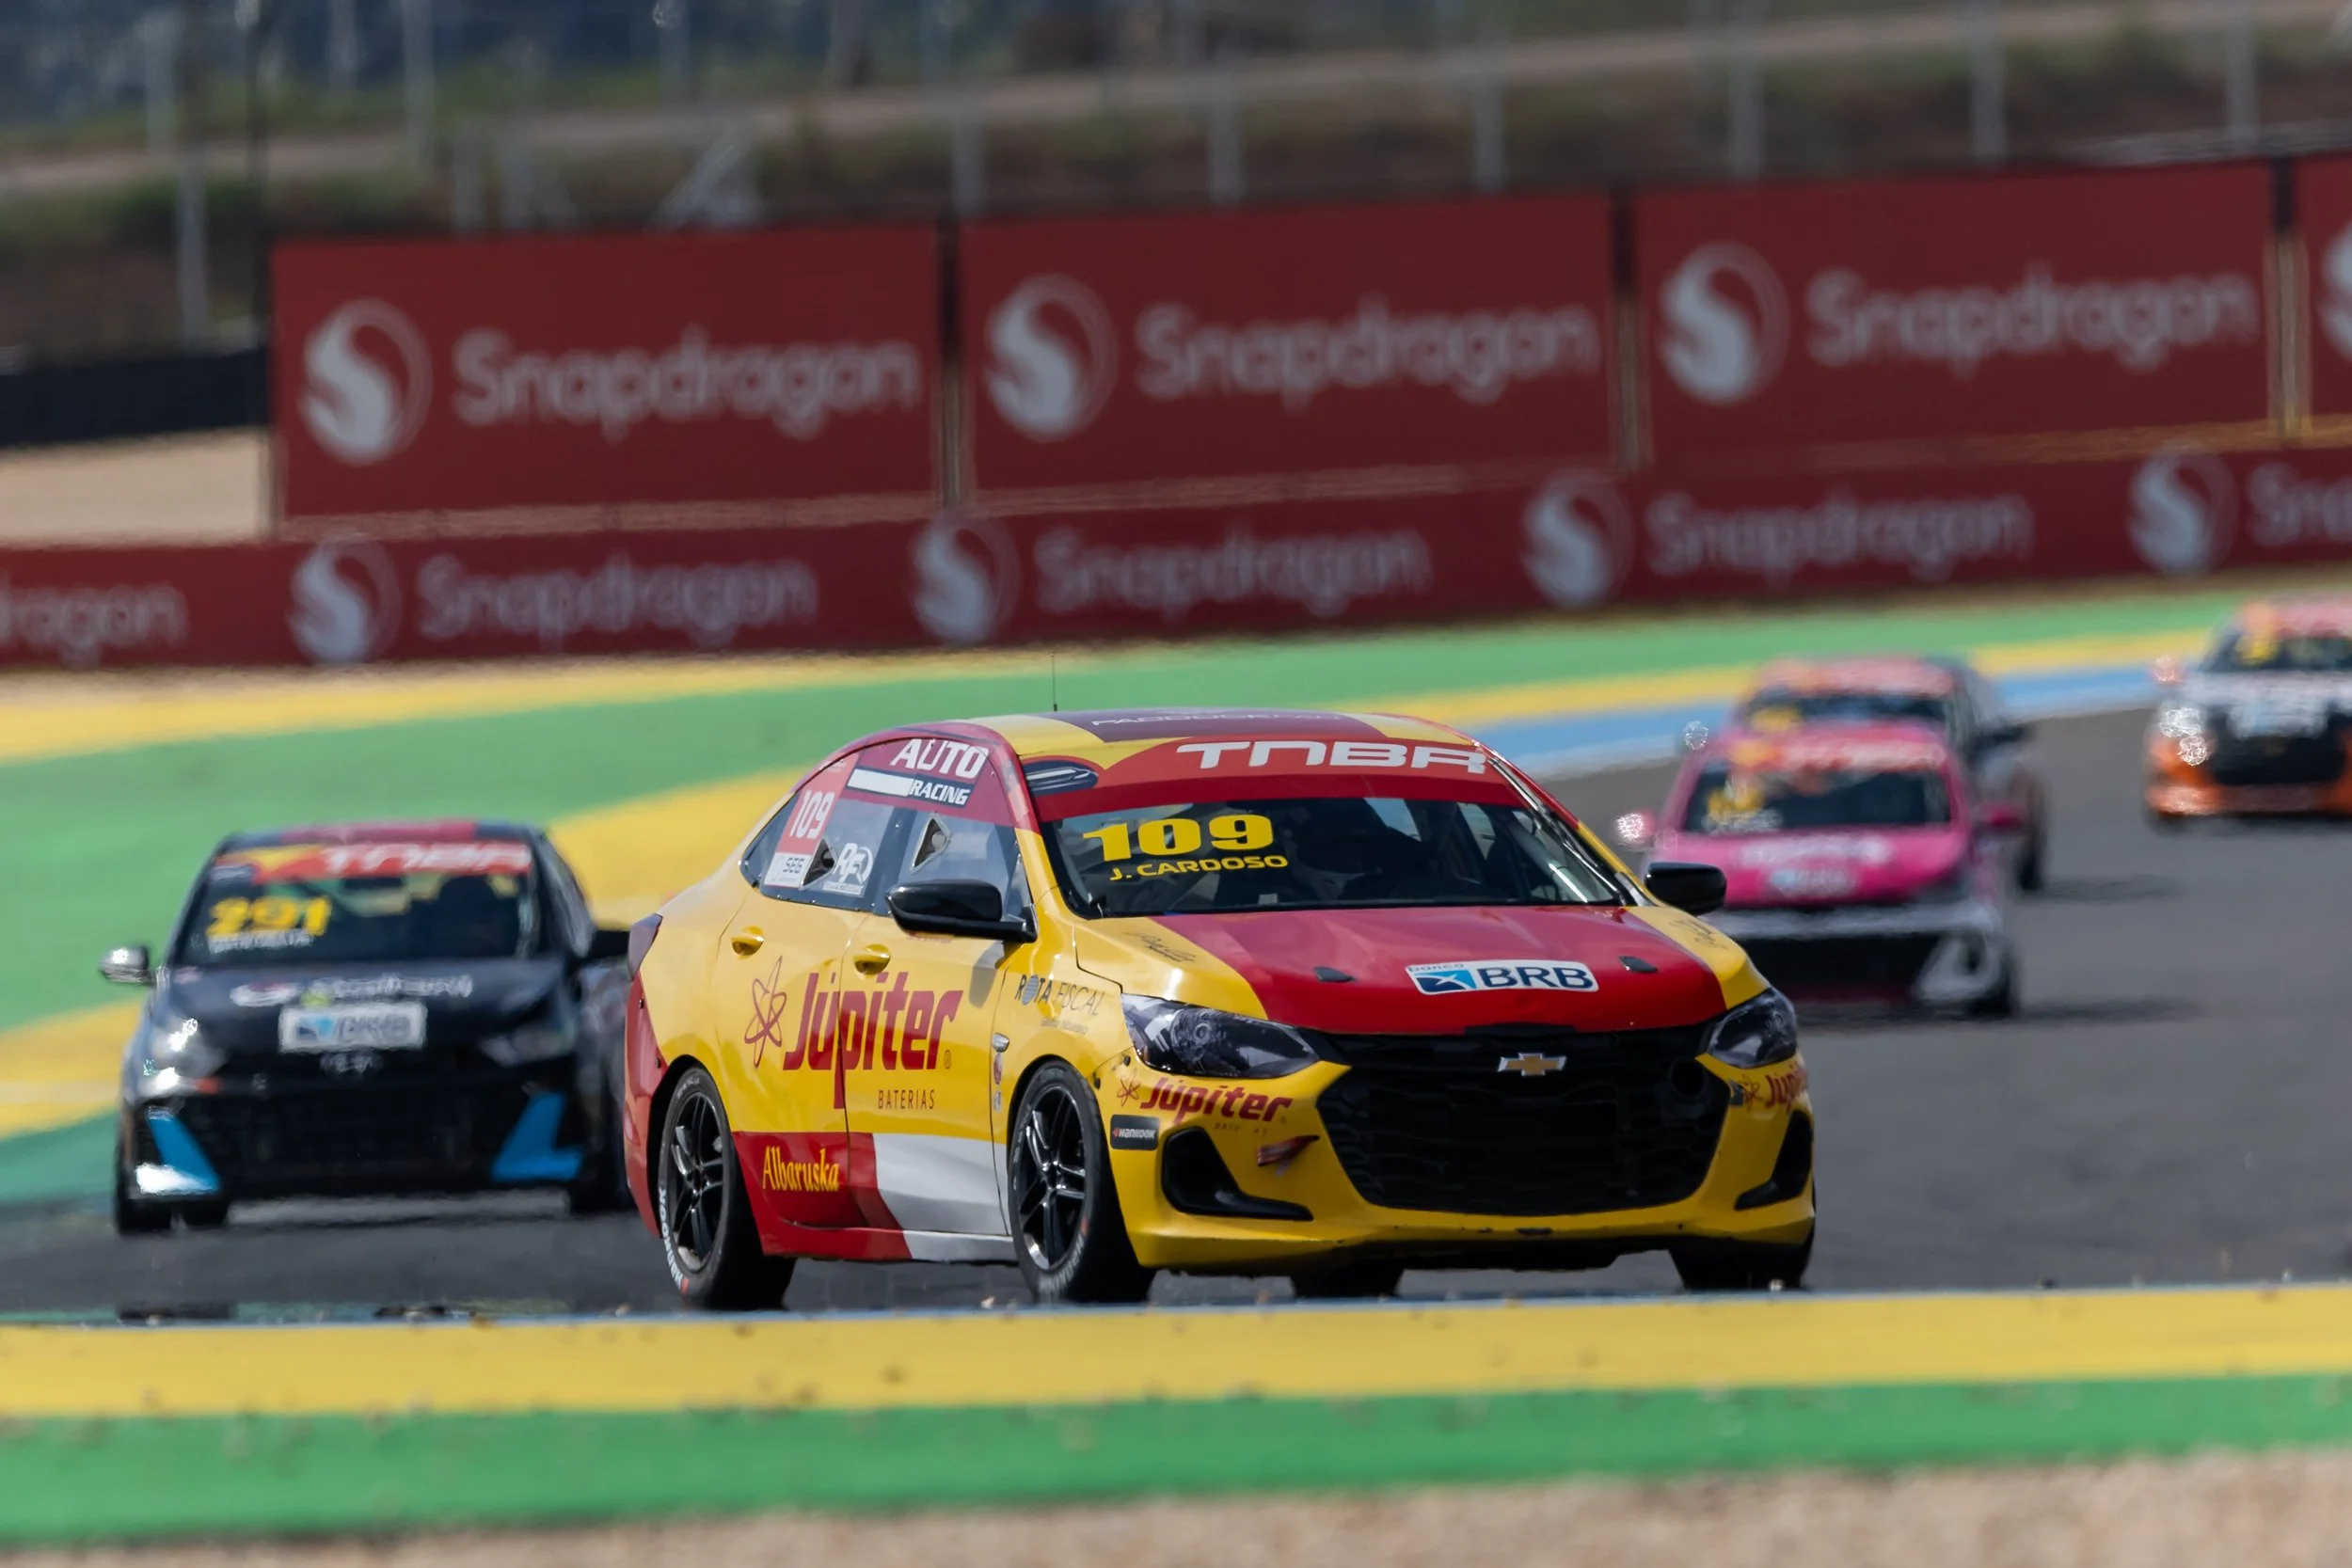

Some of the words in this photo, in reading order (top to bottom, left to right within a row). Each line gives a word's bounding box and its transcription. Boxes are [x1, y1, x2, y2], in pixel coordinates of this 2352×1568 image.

[1806, 262, 2253, 378] Snapdragon
[1136, 294, 1598, 412] Snapdragon
[454, 325, 920, 441] Snapdragon
[1648, 484, 2030, 585] Snapdragon
[1036, 527, 1427, 617] Snapdragon
[0, 574, 188, 665] ragon
[419, 551, 816, 645] Snapdragon
[890, 738, 989, 779] AUTO
[1177, 740, 1486, 774] TNBR
[789, 789, 834, 840] 109
[910, 779, 971, 805] RACING
[1083, 814, 1274, 862] 109
[1109, 867, 1132, 881] J.
[1136, 855, 1288, 876] CARDOSO
[1056, 982, 1105, 1017] FISCAL
[1477, 967, 1593, 988] BRB
[879, 1088, 935, 1110] BATERIAS
[762, 1146, 840, 1193] Albaruska
